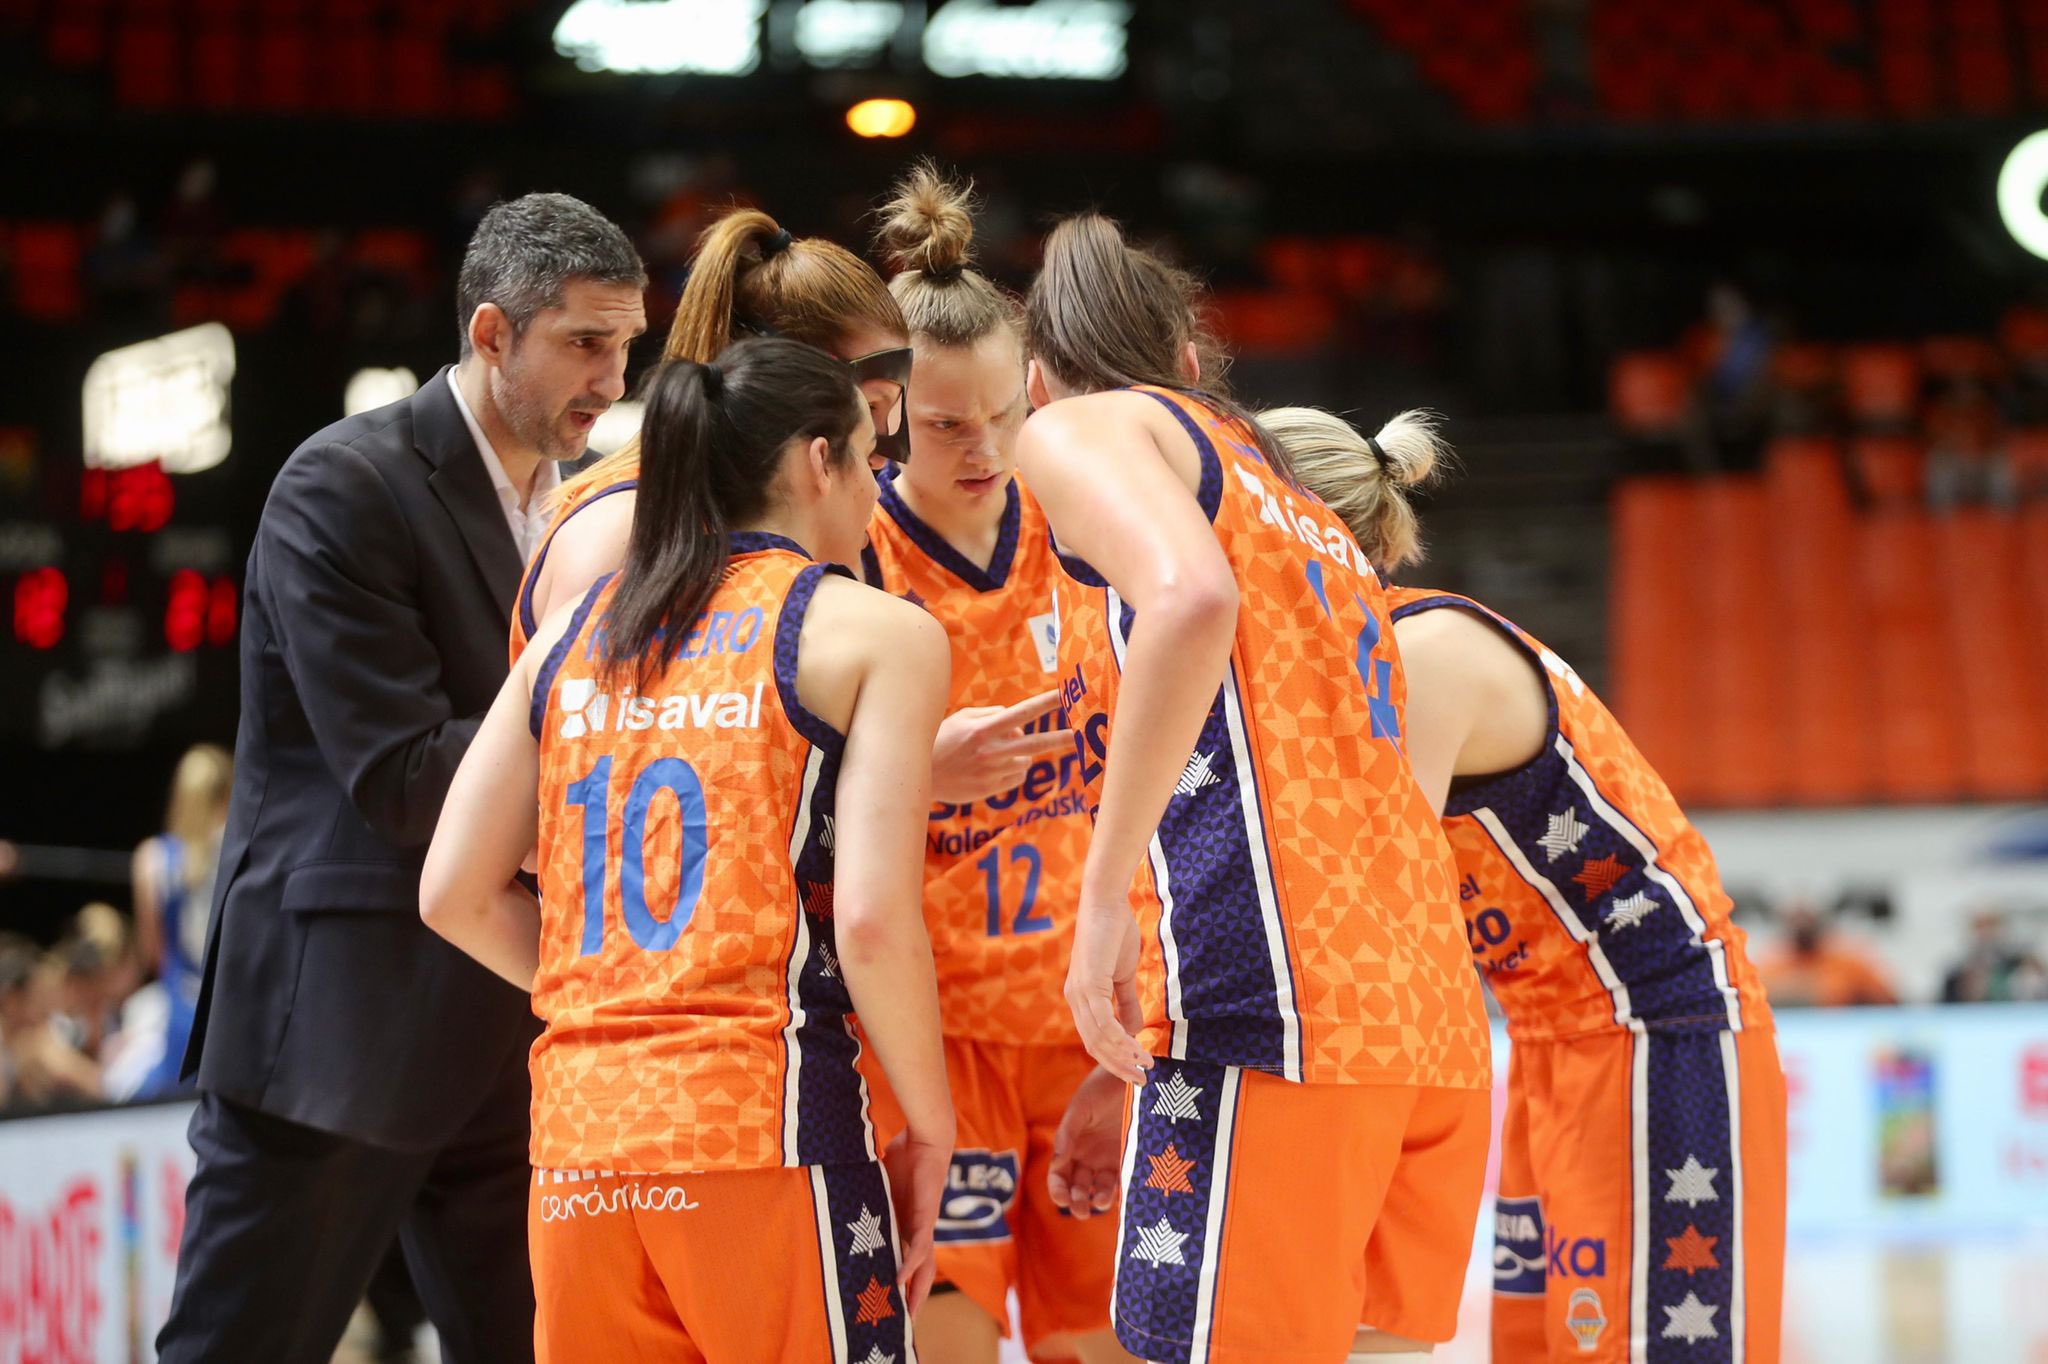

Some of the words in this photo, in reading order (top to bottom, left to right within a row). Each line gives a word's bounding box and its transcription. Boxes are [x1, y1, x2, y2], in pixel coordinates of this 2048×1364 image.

[616, 681, 764, 732] isaval
[566, 755, 709, 957] 10
[977, 843, 1054, 938] 12
